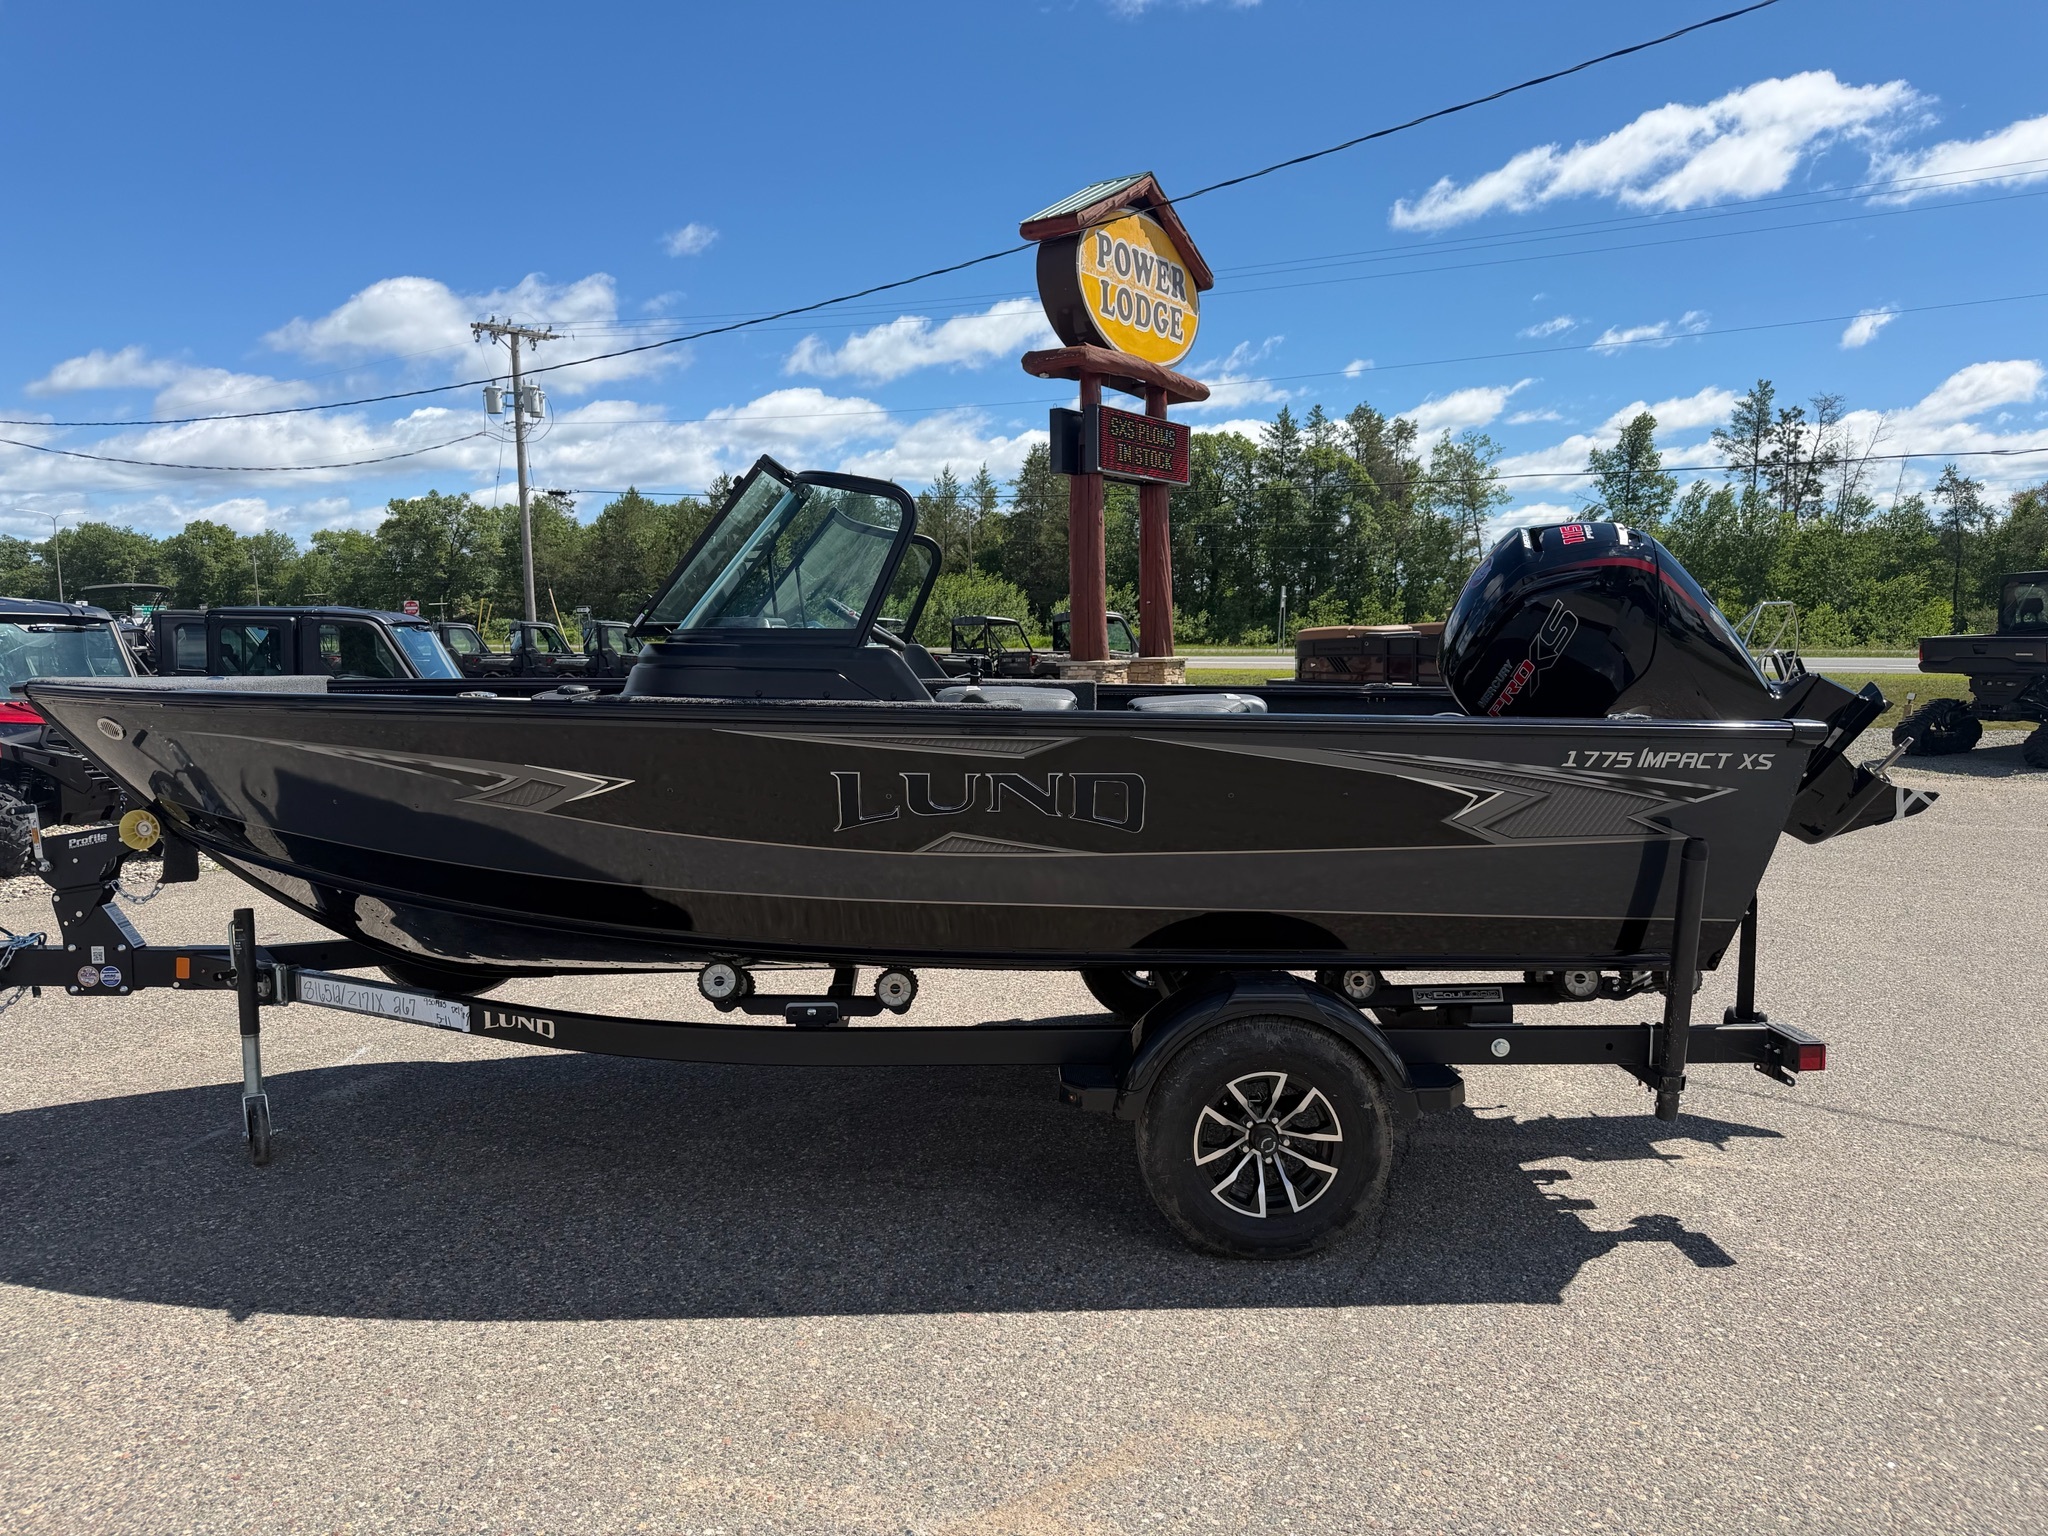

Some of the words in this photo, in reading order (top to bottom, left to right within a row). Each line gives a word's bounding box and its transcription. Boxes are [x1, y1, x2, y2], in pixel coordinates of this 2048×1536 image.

[1096, 230, 1187, 303] POWER
[1100, 278, 1184, 342] LODGE
[1138, 423, 1176, 448] PLOWS
[1118, 443, 1132, 462] IN
[1135, 447, 1173, 470] STOCK
[1487, 659, 1536, 718] PRO
[1529, 598, 1579, 698] XS
[1477, 659, 1513, 709] MERCURY
[1561, 750, 1636, 769] 1775
[1637, 747, 1734, 769] IMPACT
[1737, 753, 1777, 770] XS
[830, 771, 1146, 834] LUND
[68, 833, 108, 847] Profile
[393, 996, 416, 1016] 267
[483, 1010, 555, 1040] LUND
